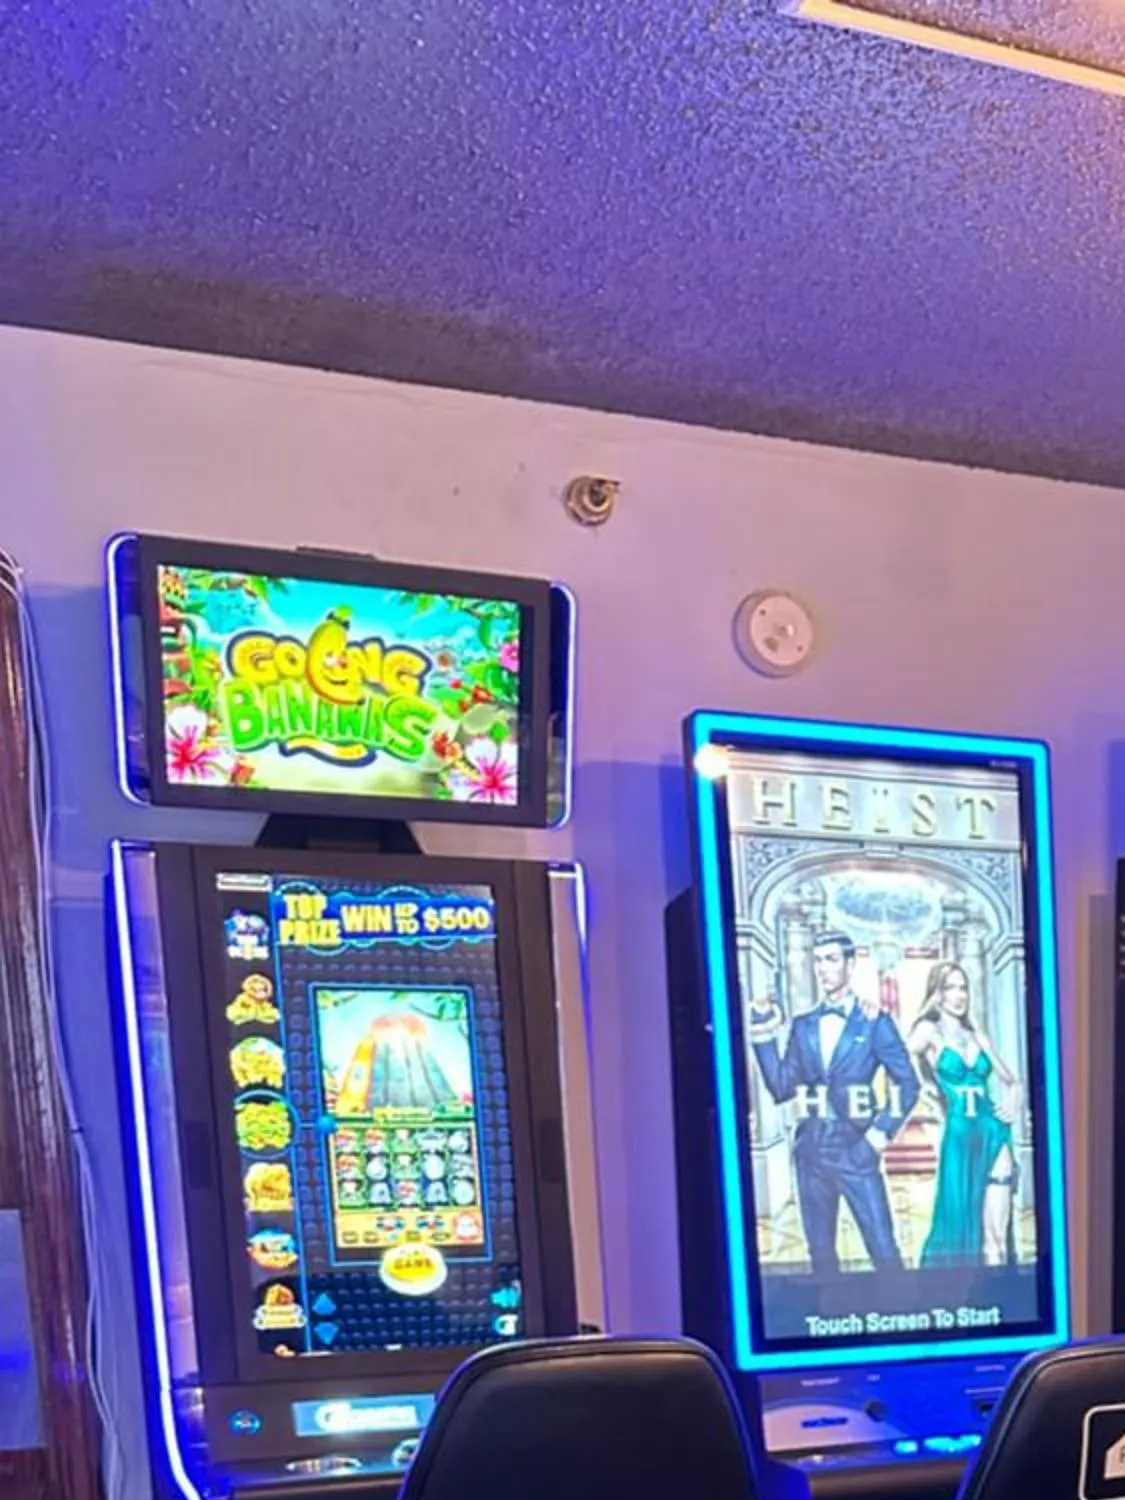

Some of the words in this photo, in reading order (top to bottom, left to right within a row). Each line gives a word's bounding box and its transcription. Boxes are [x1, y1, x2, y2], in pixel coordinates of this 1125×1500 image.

[223, 680, 438, 759] BANANAS
[282, 893, 327, 919] TOP
[341, 904, 393, 933] WIN
[423, 906, 490, 932] $500
[279, 918, 341, 946] PRIZE
[795, 1083, 985, 1119] HEIST
[805, 1312, 863, 1337] Touch
[865, 1311, 929, 1333] Screen
[931, 1308, 953, 1328] To
[956, 1306, 1000, 1326] Start
